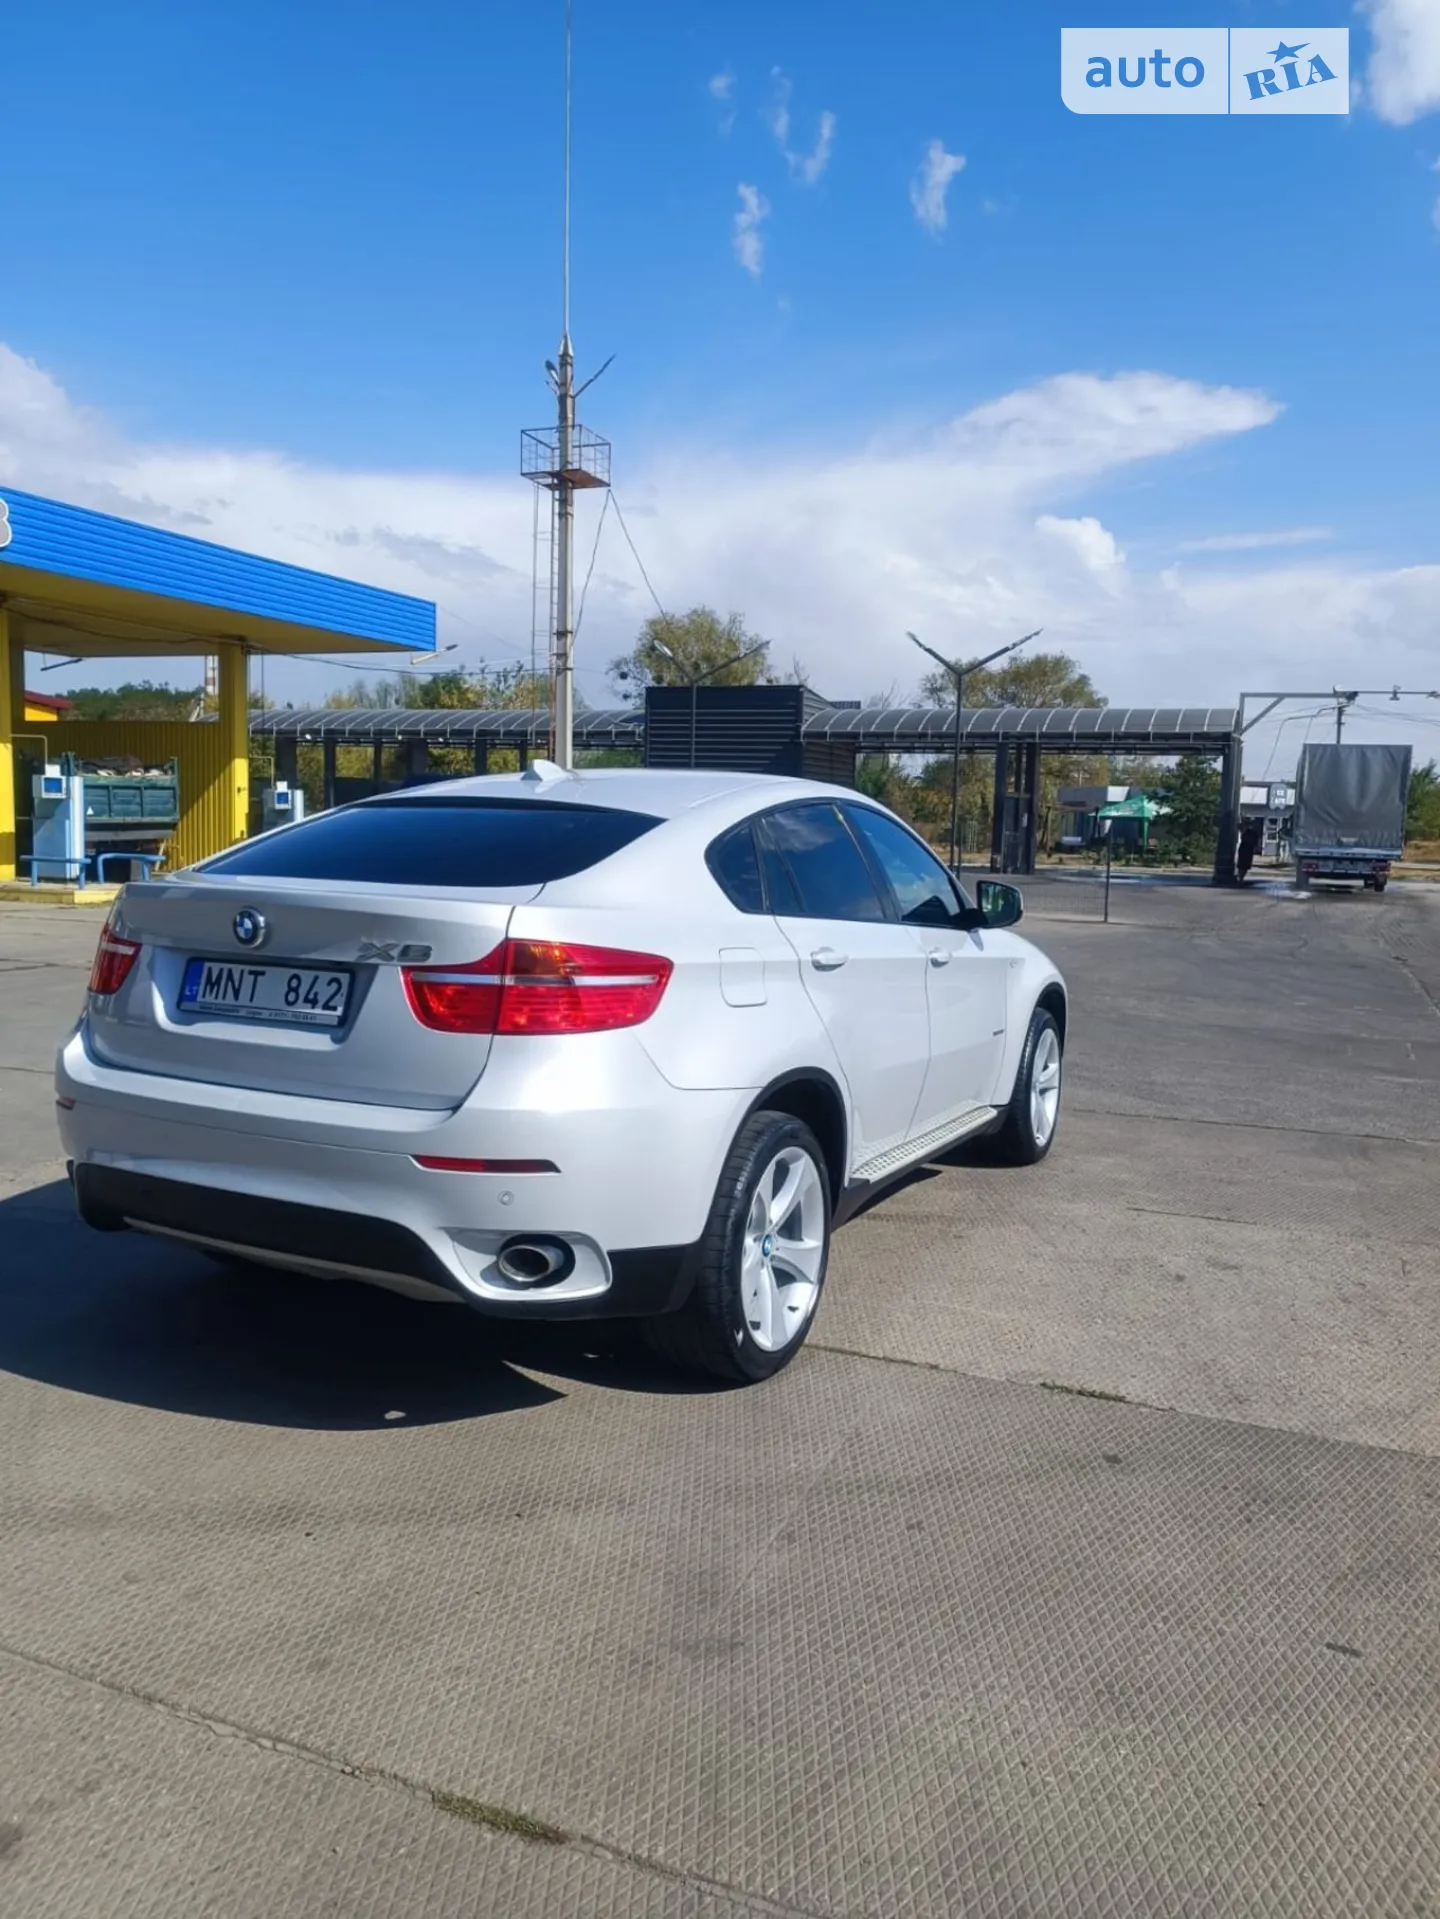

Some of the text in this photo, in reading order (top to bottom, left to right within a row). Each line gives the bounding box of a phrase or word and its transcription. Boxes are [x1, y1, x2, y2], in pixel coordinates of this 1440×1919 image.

[355, 937, 433, 963] X6
[184, 984, 199, 996] LT
[202, 966, 343, 1012] MNT 842
